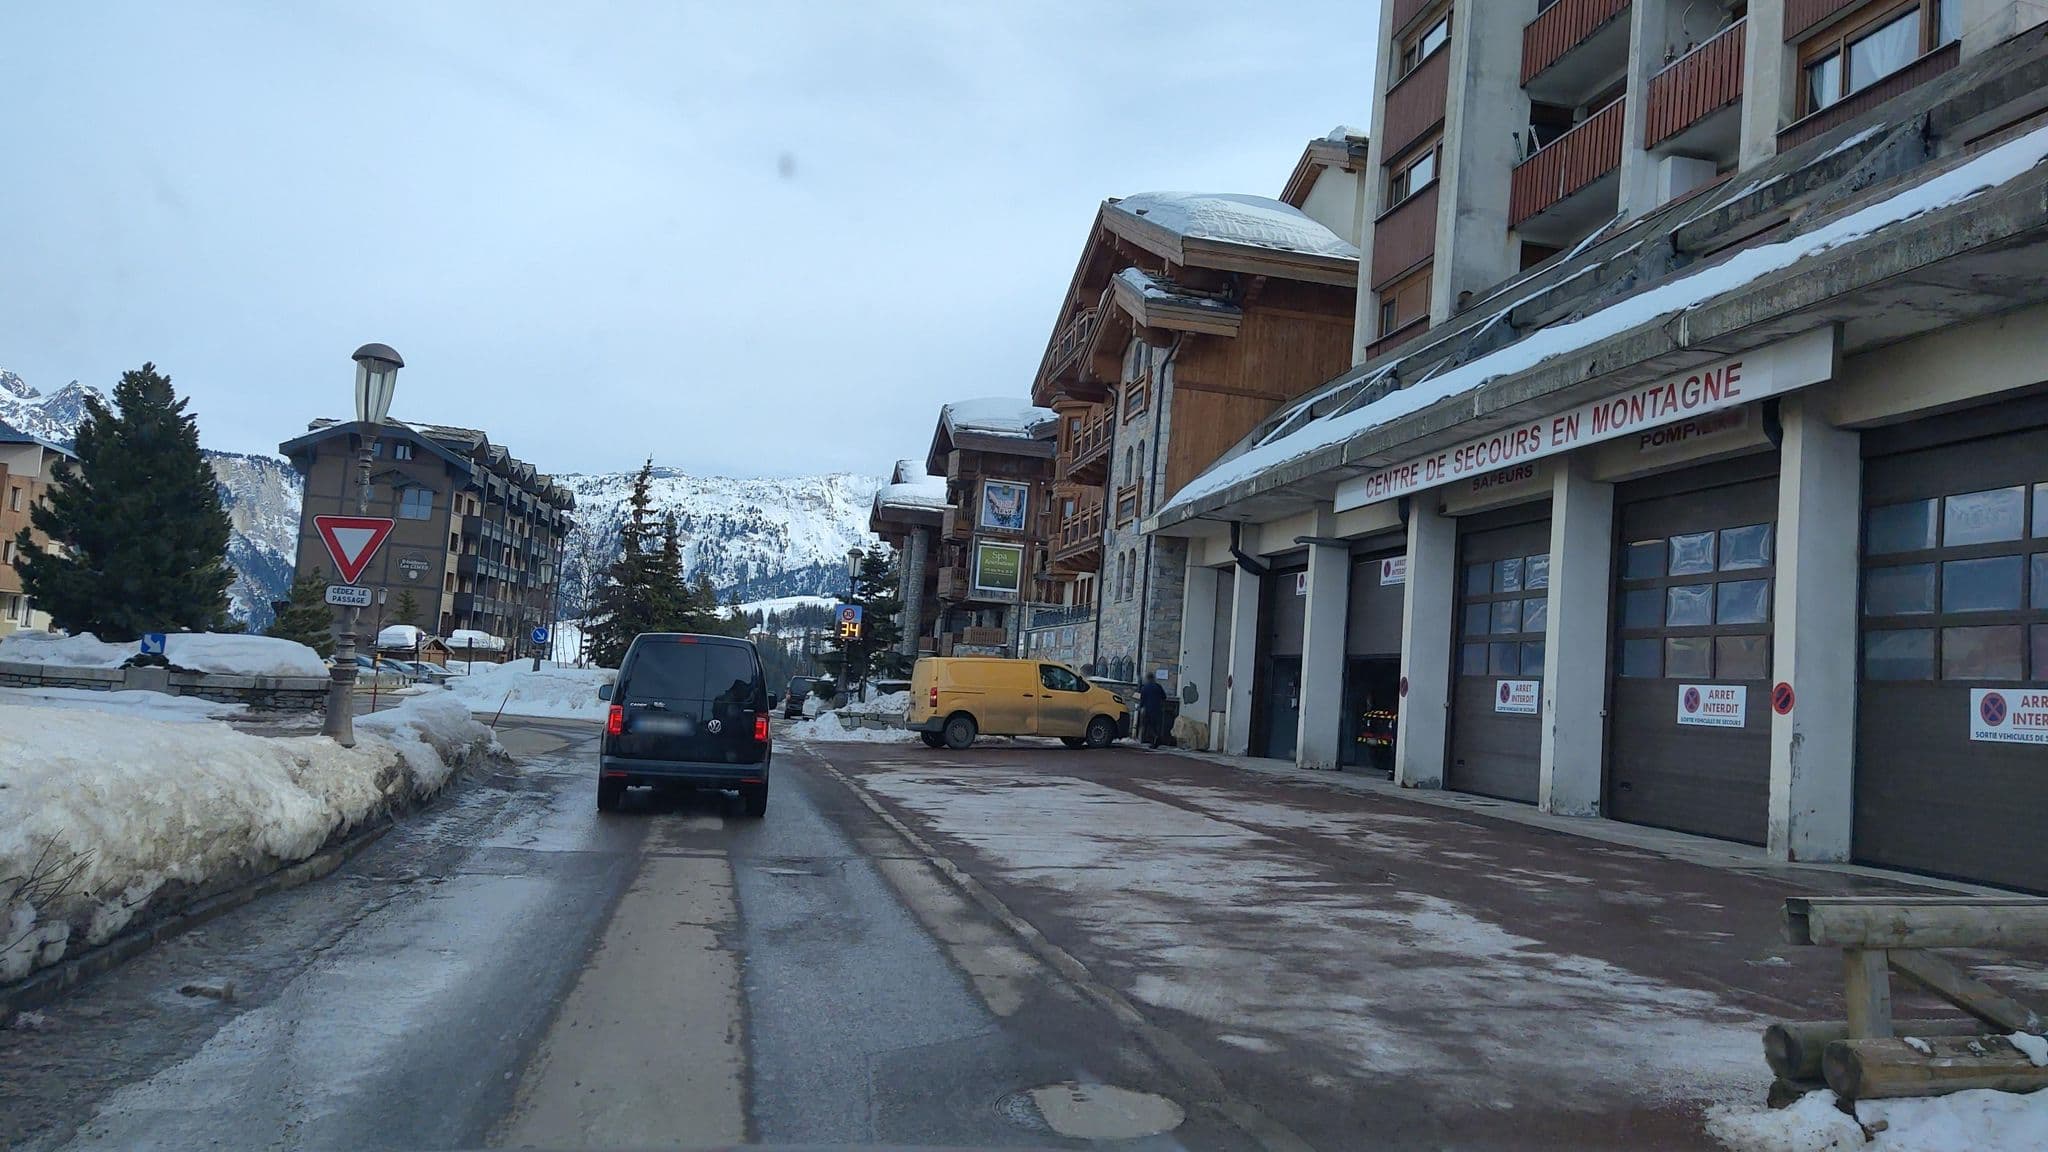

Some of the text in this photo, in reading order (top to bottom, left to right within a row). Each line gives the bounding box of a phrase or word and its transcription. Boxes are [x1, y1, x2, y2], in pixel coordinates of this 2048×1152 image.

[1365, 362, 1743, 498] CENTRE DE SECOURS EN MONTAGNE
[1472, 464, 1533, 491] SAPEURS
[991, 551, 1008, 561] Spa
[332, 596, 366, 604] PASSAGE
[841, 622, 859, 637] 34
[1516, 684, 1532, 692] ARRET
[1511, 695, 1534, 703] INTERDIT
[1708, 689, 1735, 700] ARRET
[1703, 703, 1739, 714] INTERDIT
[1975, 731, 1997, 739] SORTIE
[1998, 732, 2033, 741] VEHICULES
[2034, 734, 2044, 742] DE
